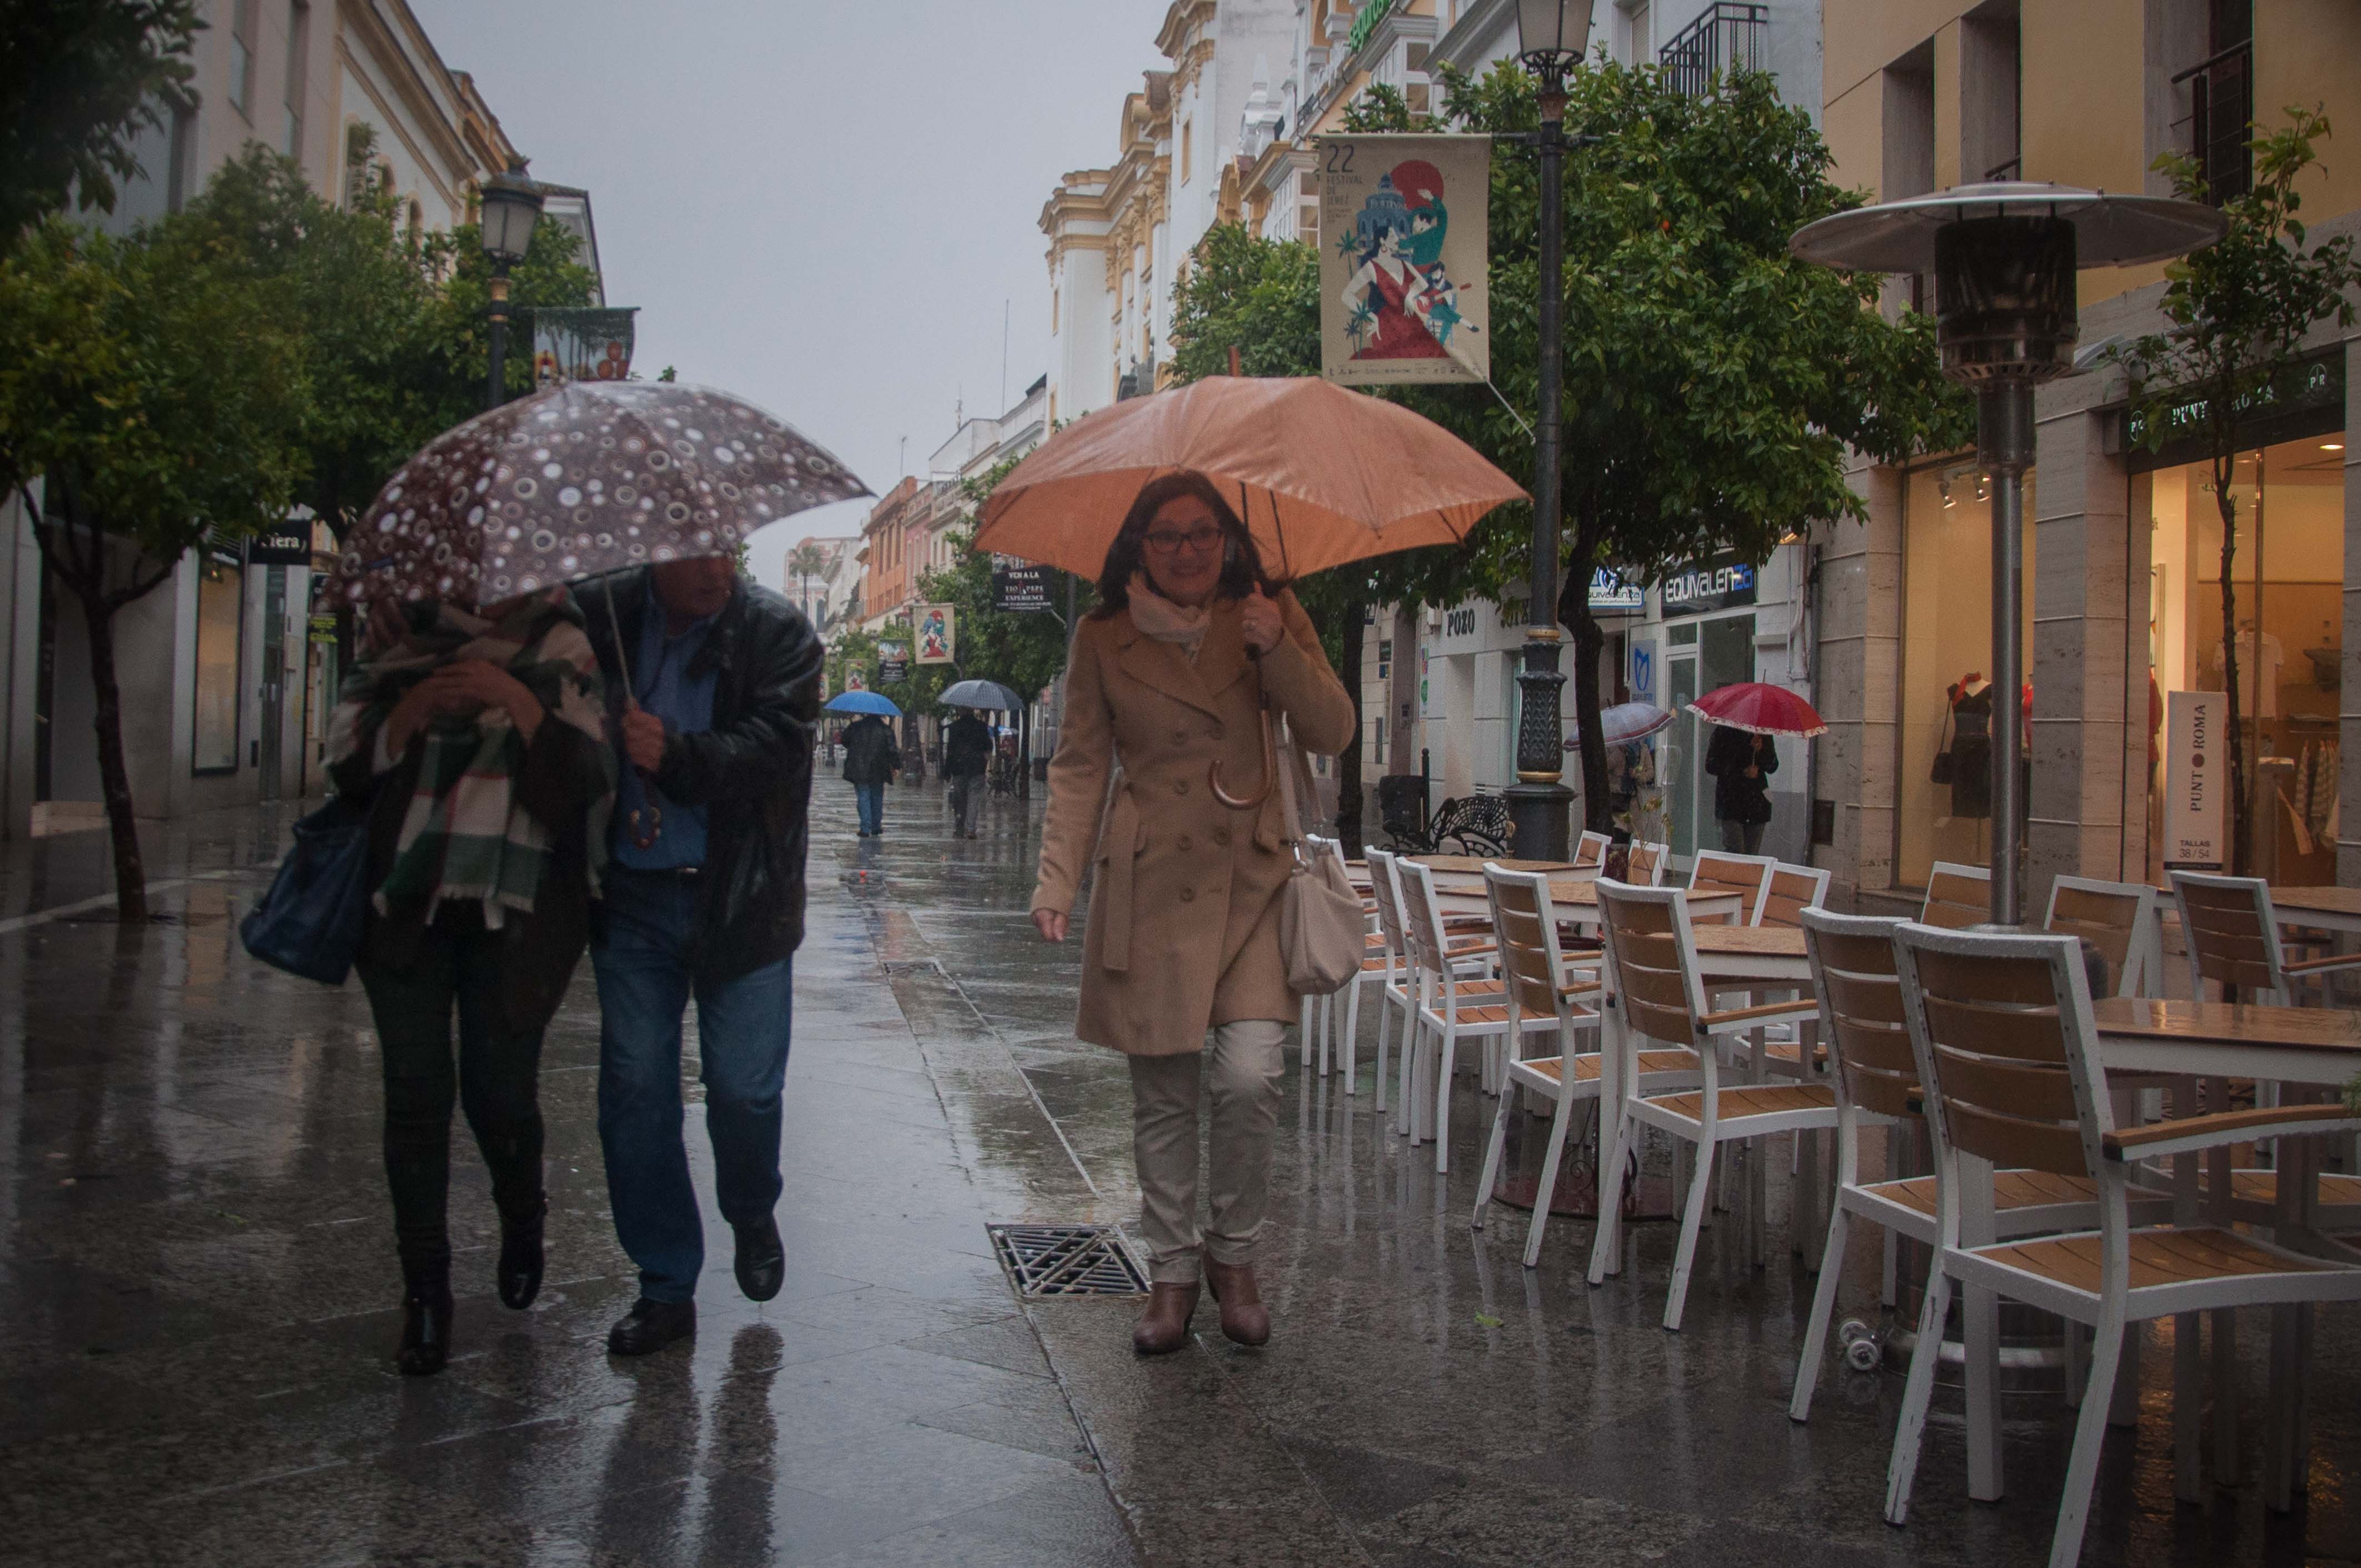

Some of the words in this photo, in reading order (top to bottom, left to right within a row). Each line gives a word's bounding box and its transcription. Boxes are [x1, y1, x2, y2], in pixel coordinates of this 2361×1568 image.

[1327, 144, 1354, 172] 22
[1327, 175, 1363, 184] FESTIVAL
[1447, 608, 1475, 637] POZO
[2193, 704, 2206, 749] ROMA
[2190, 770, 2203, 813] PUNT
[2179, 849, 2191, 858] 38
[2198, 849, 2210, 859] 54
